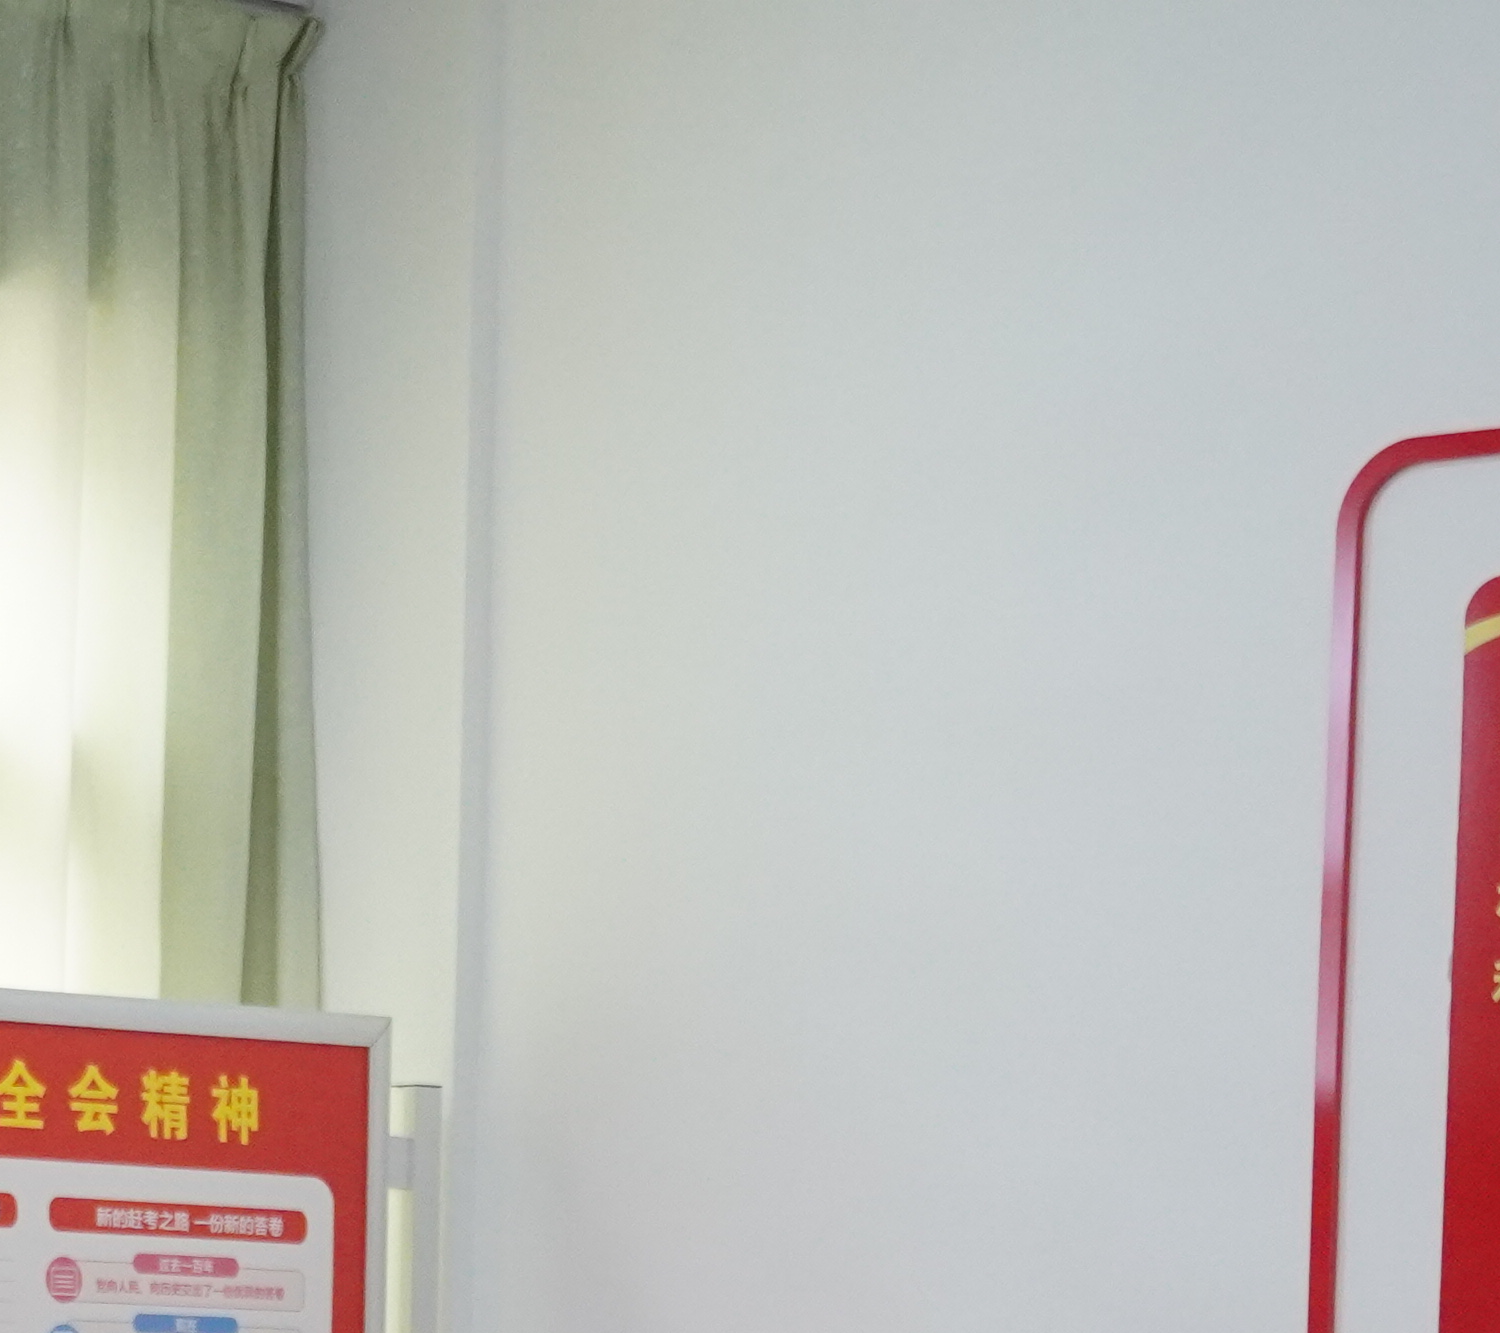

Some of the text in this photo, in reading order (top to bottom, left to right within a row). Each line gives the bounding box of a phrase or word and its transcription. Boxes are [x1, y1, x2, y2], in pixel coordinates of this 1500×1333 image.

[96, 1207, 284, 1237] 新的赶考之路 一份新的答卷
